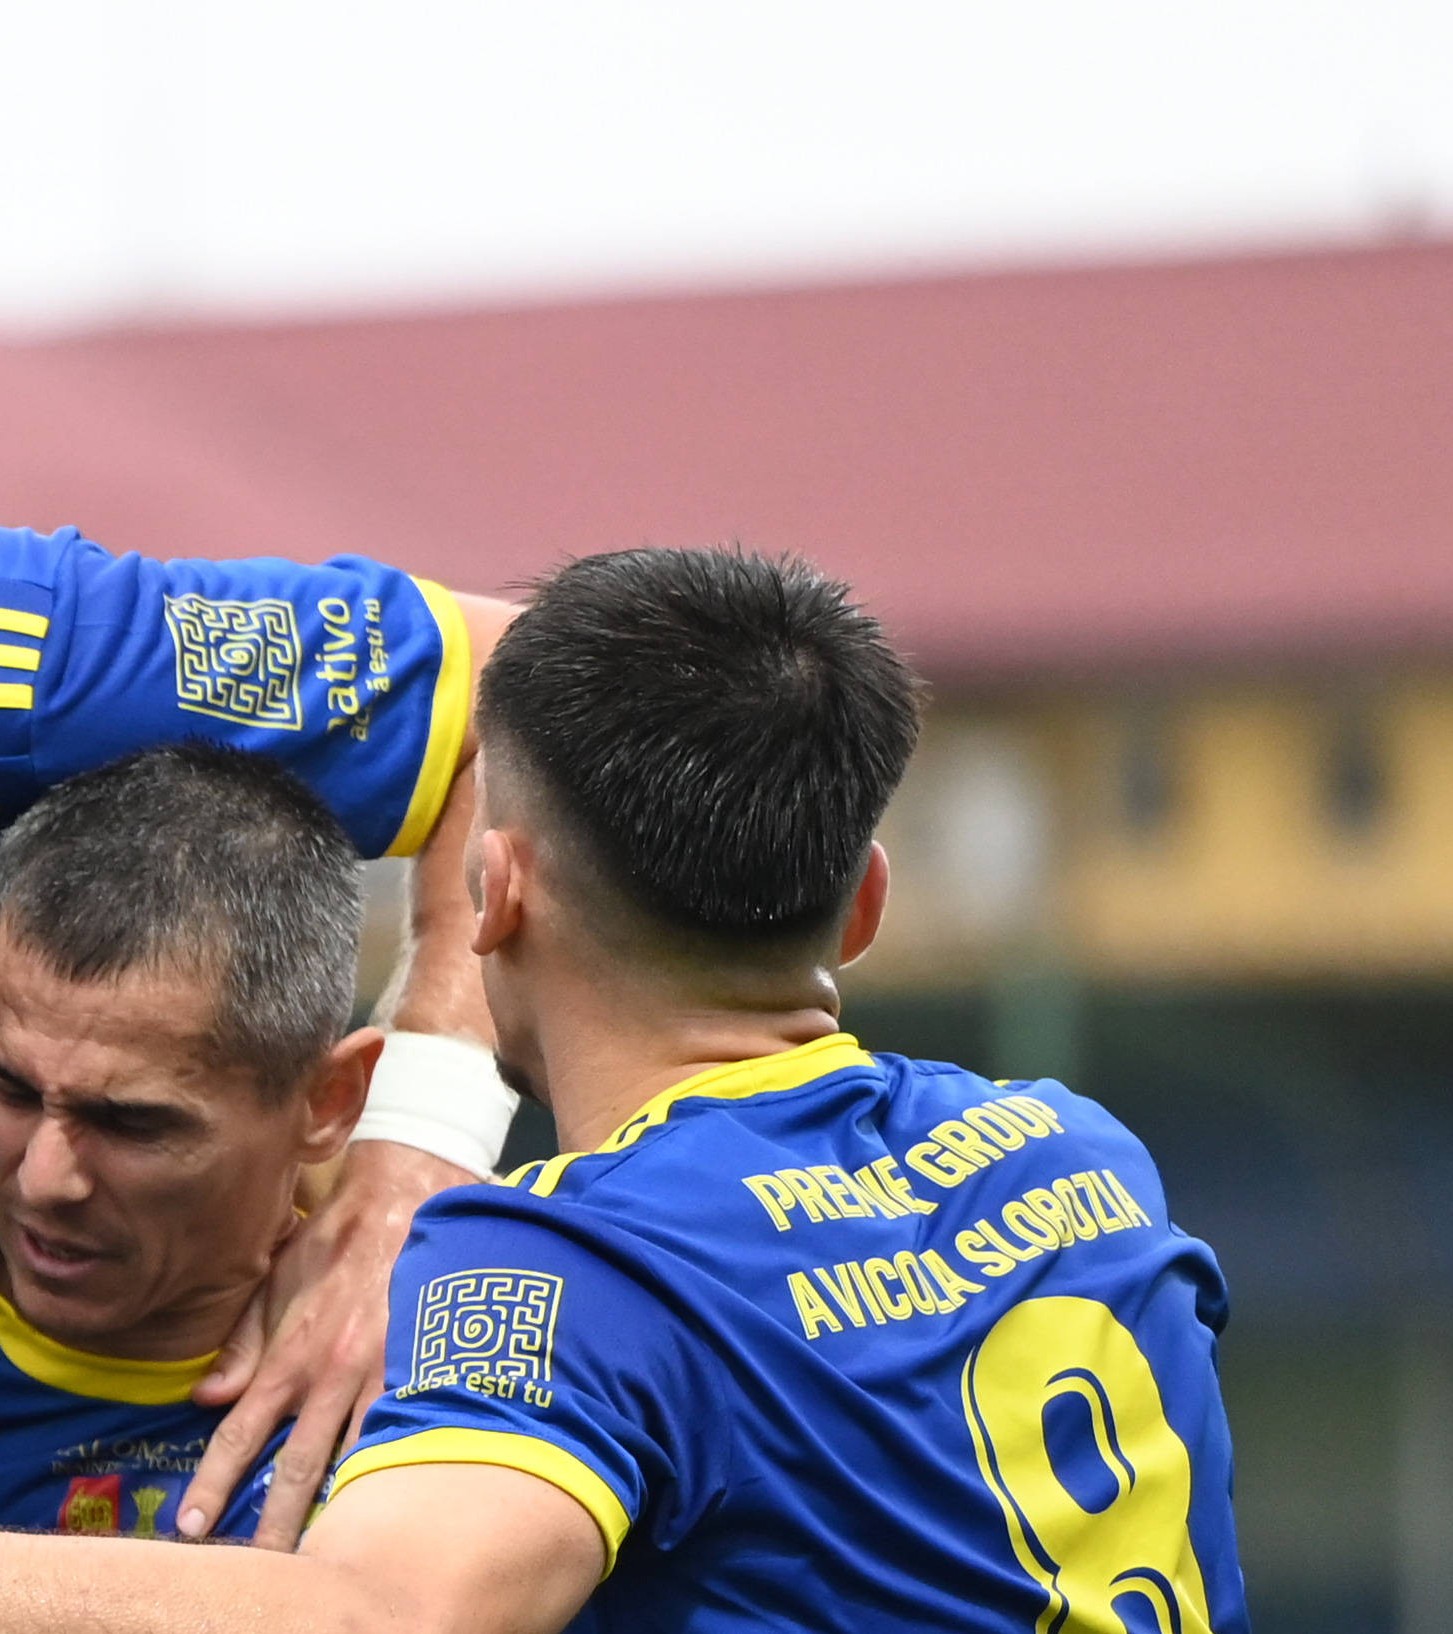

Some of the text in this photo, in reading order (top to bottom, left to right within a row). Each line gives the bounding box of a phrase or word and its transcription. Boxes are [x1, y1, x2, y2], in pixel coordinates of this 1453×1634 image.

[904, 1095, 1065, 1188] GROUP
[787, 1169, 1152, 1340] AVICOLA SLOBOZIA
[465, 1372, 518, 1398] ești
[523, 1380, 553, 1408] tu
